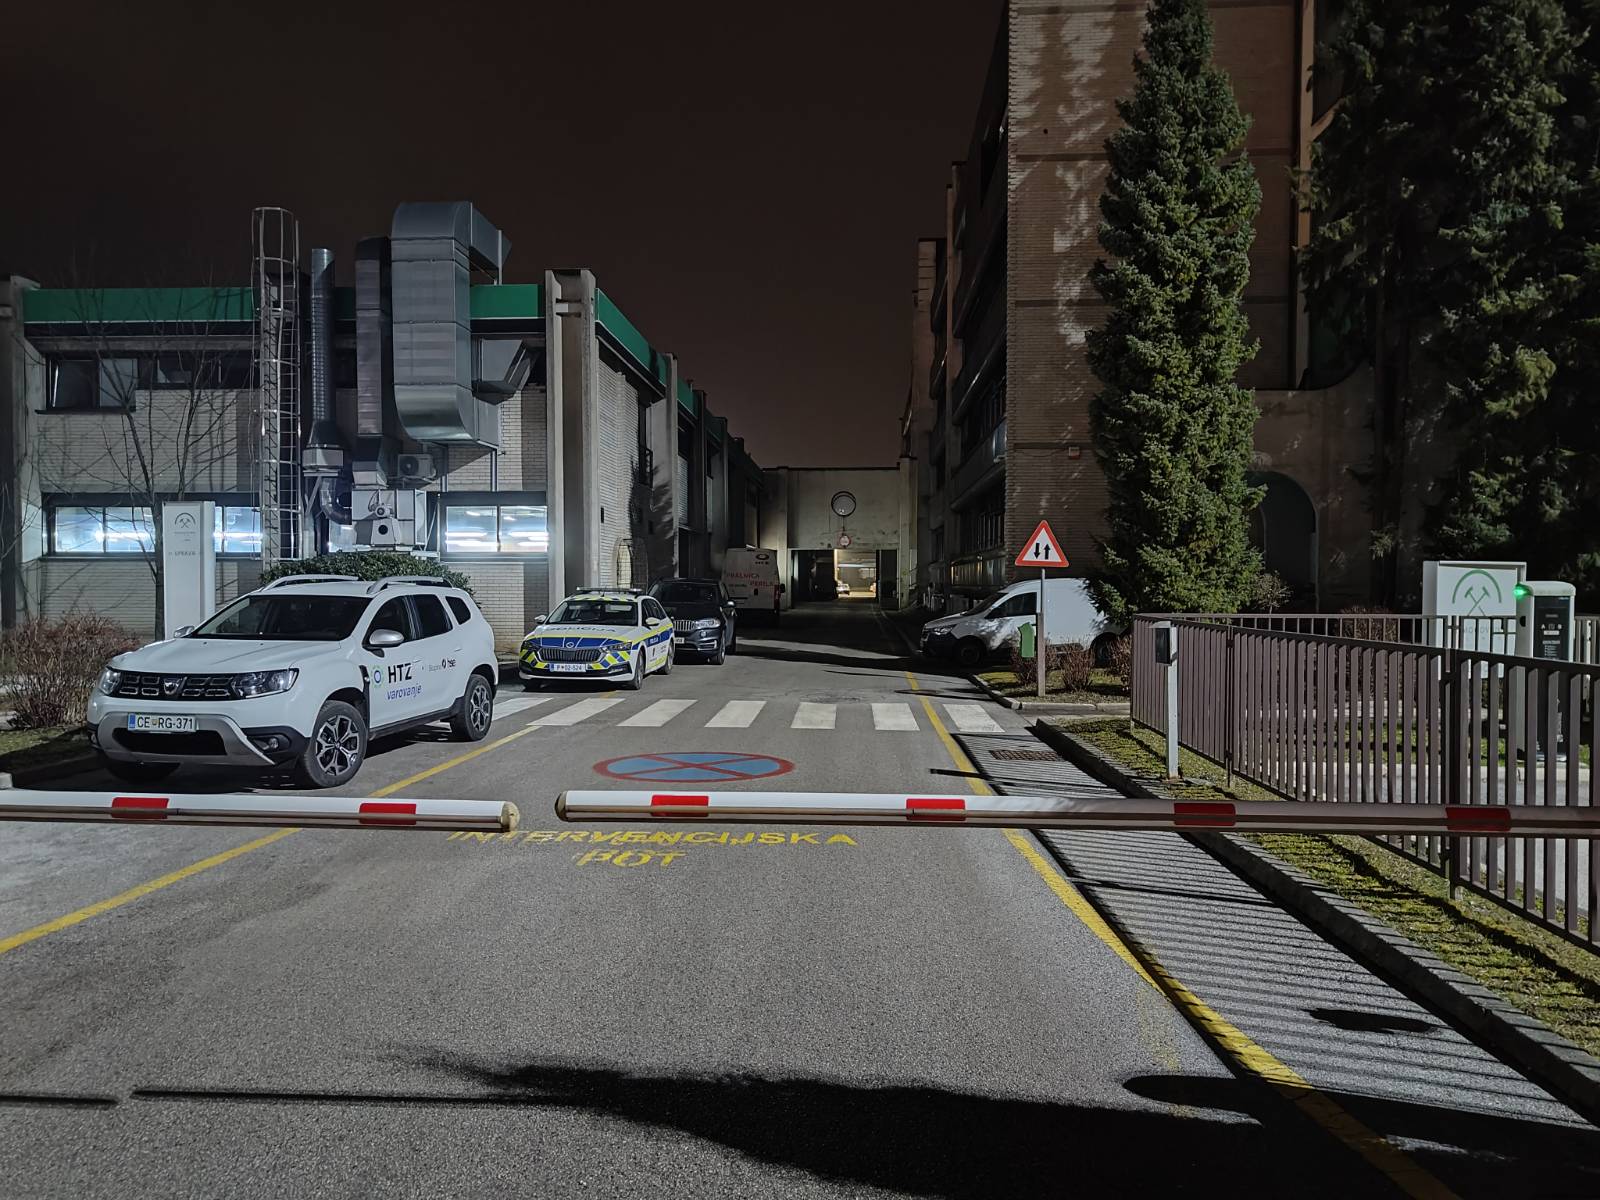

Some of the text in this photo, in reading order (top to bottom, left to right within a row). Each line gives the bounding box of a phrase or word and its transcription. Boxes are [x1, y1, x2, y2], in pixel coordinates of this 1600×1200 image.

[387, 662, 413, 684] HTZ
[386, 683, 422, 701] varovanje
[137, 716, 193, 730] CE RG-371
[446, 830, 858, 846] INTERVENCIJSKA
[574, 849, 687, 867] POT
